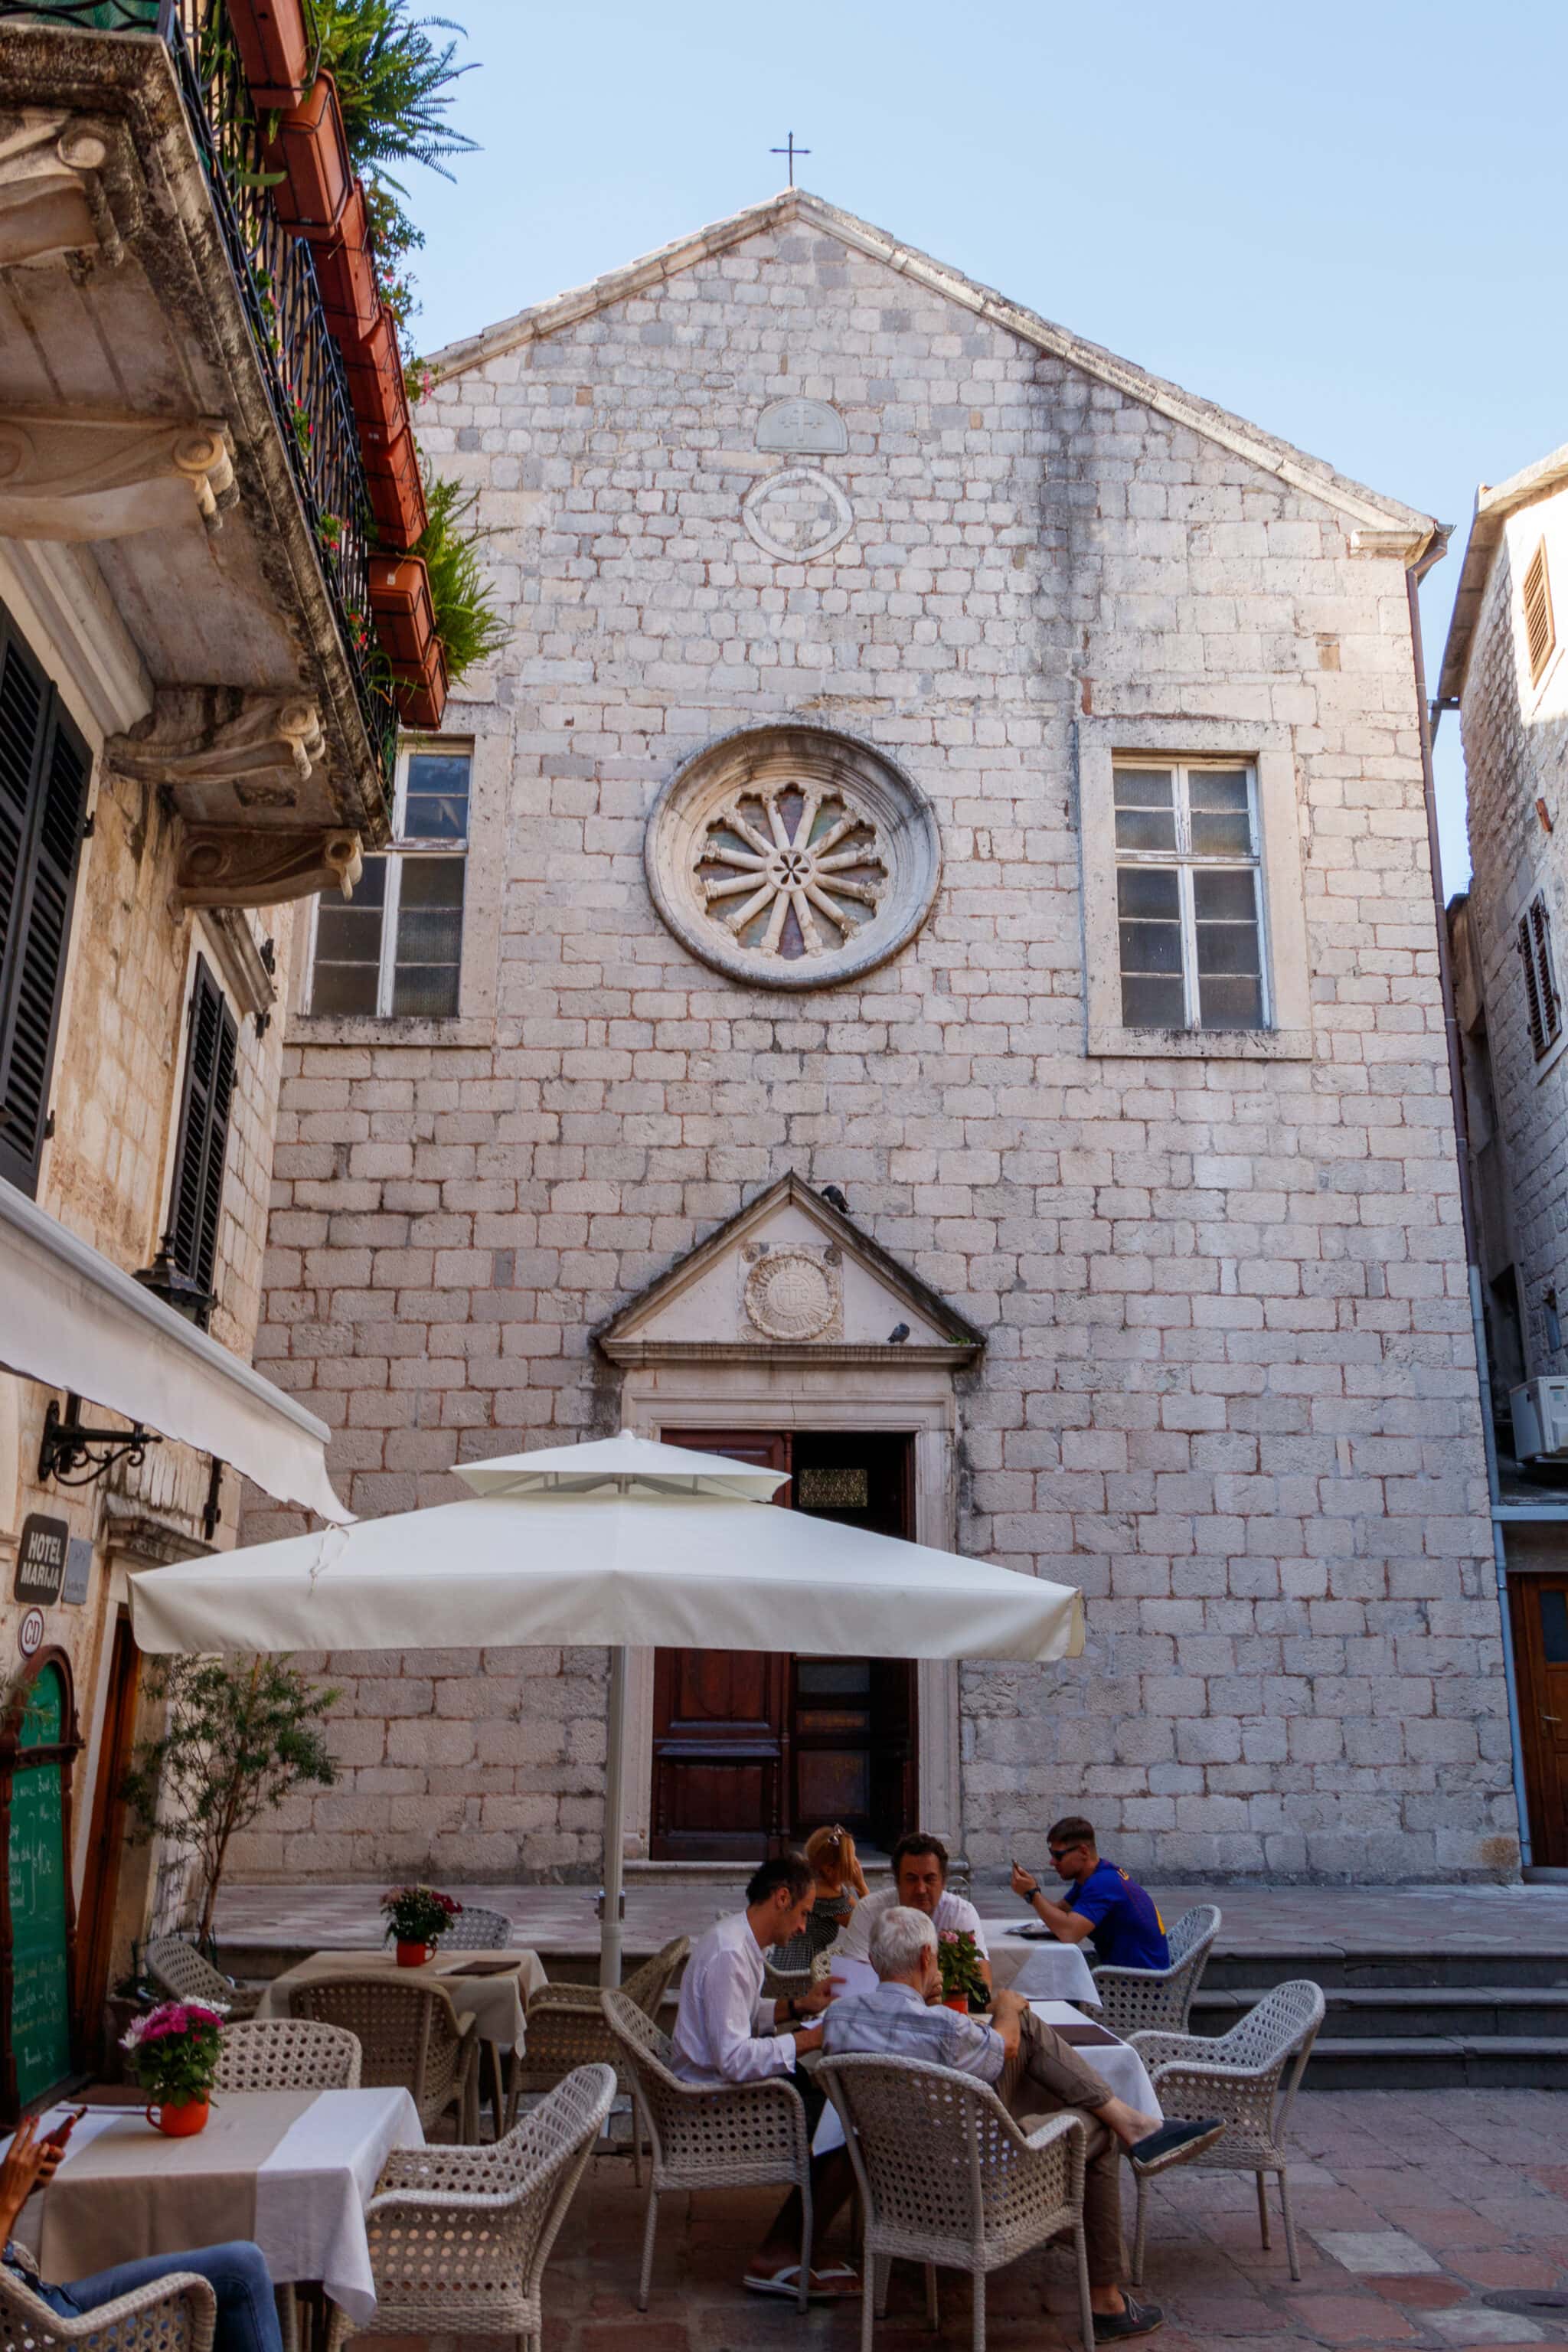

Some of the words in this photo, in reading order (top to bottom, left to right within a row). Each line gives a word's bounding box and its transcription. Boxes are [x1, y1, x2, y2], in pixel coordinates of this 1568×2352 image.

[28, 1531, 61, 1565] HOTEL
[21, 1561, 59, 1589] MARIJA
[24, 1619, 39, 1645] CD
